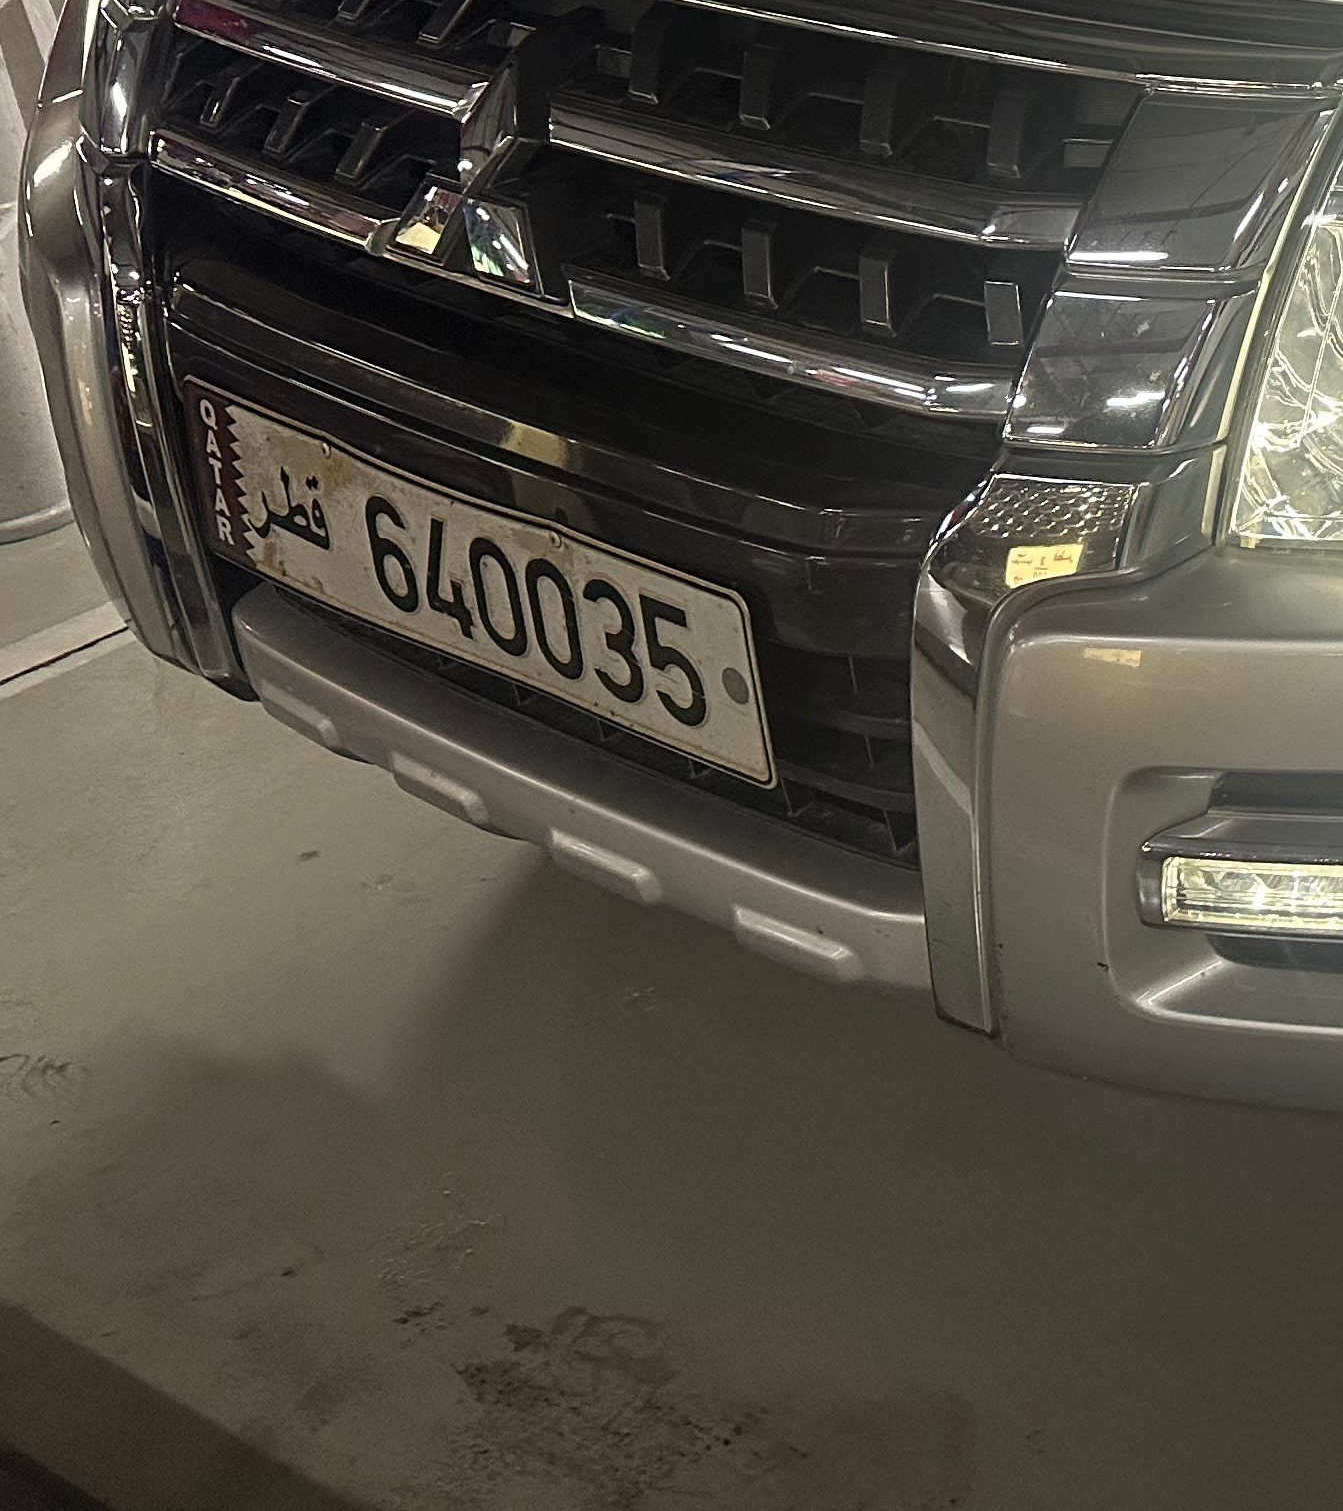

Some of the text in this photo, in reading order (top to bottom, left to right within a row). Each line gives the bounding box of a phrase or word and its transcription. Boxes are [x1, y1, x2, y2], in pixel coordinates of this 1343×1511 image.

[200, 399, 235, 546] QATAR
[248, 466, 330, 550] قطر
[364, 495, 708, 727] 640035
